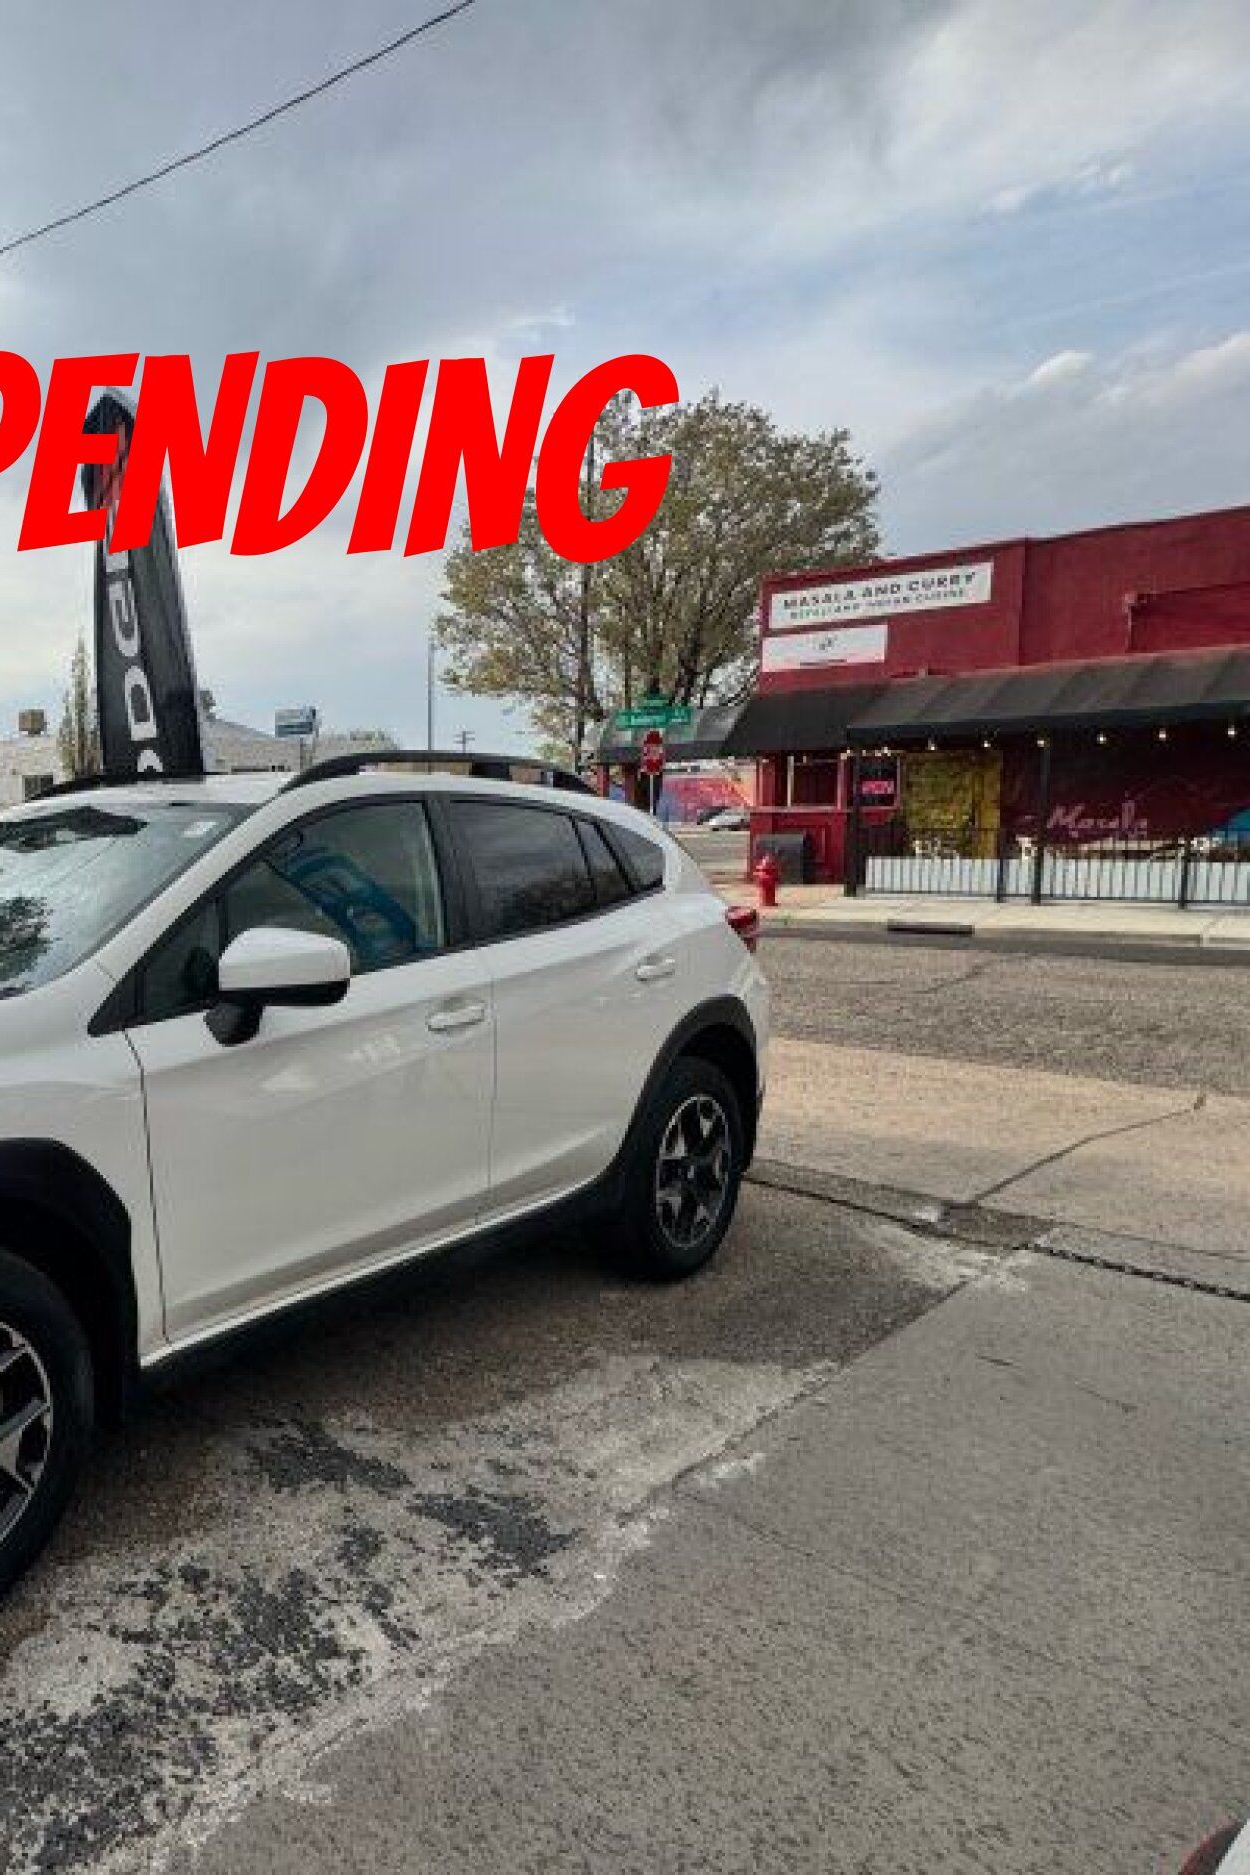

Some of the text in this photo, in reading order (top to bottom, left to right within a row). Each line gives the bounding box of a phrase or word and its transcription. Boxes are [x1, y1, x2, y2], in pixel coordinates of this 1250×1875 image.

[783, 571, 976, 610] MASALA AND CURRY
